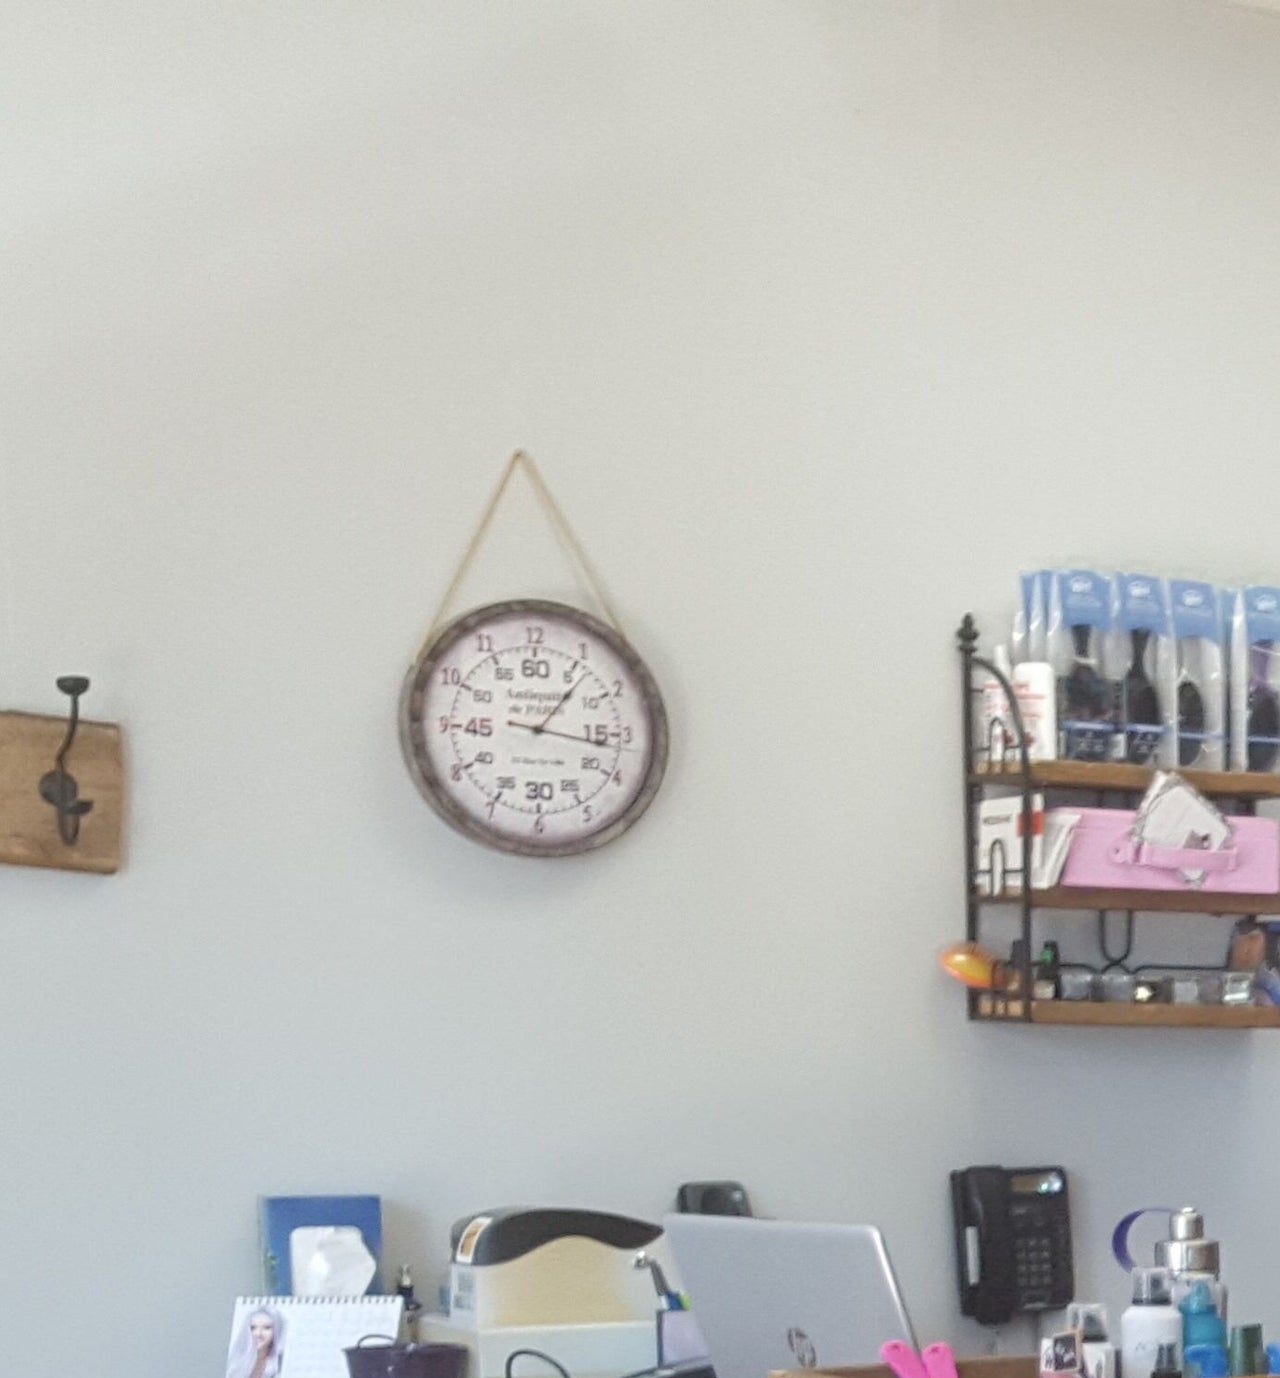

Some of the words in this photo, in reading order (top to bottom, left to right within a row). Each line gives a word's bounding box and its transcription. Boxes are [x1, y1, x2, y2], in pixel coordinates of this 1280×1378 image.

[477, 635, 492, 652] 11
[527, 627, 543, 644] 12
[441, 668, 460, 685] 10
[521, 659, 549, 679] 60
[613, 680, 623, 698] 2
[464, 718, 493, 737] 45
[584, 724, 608, 743] 15
[623, 726, 632, 744] 3
[474, 751, 493, 765] 40
[581, 757, 600, 770] 20
[497, 776, 516, 789] 35
[525, 781, 553, 801] 30
